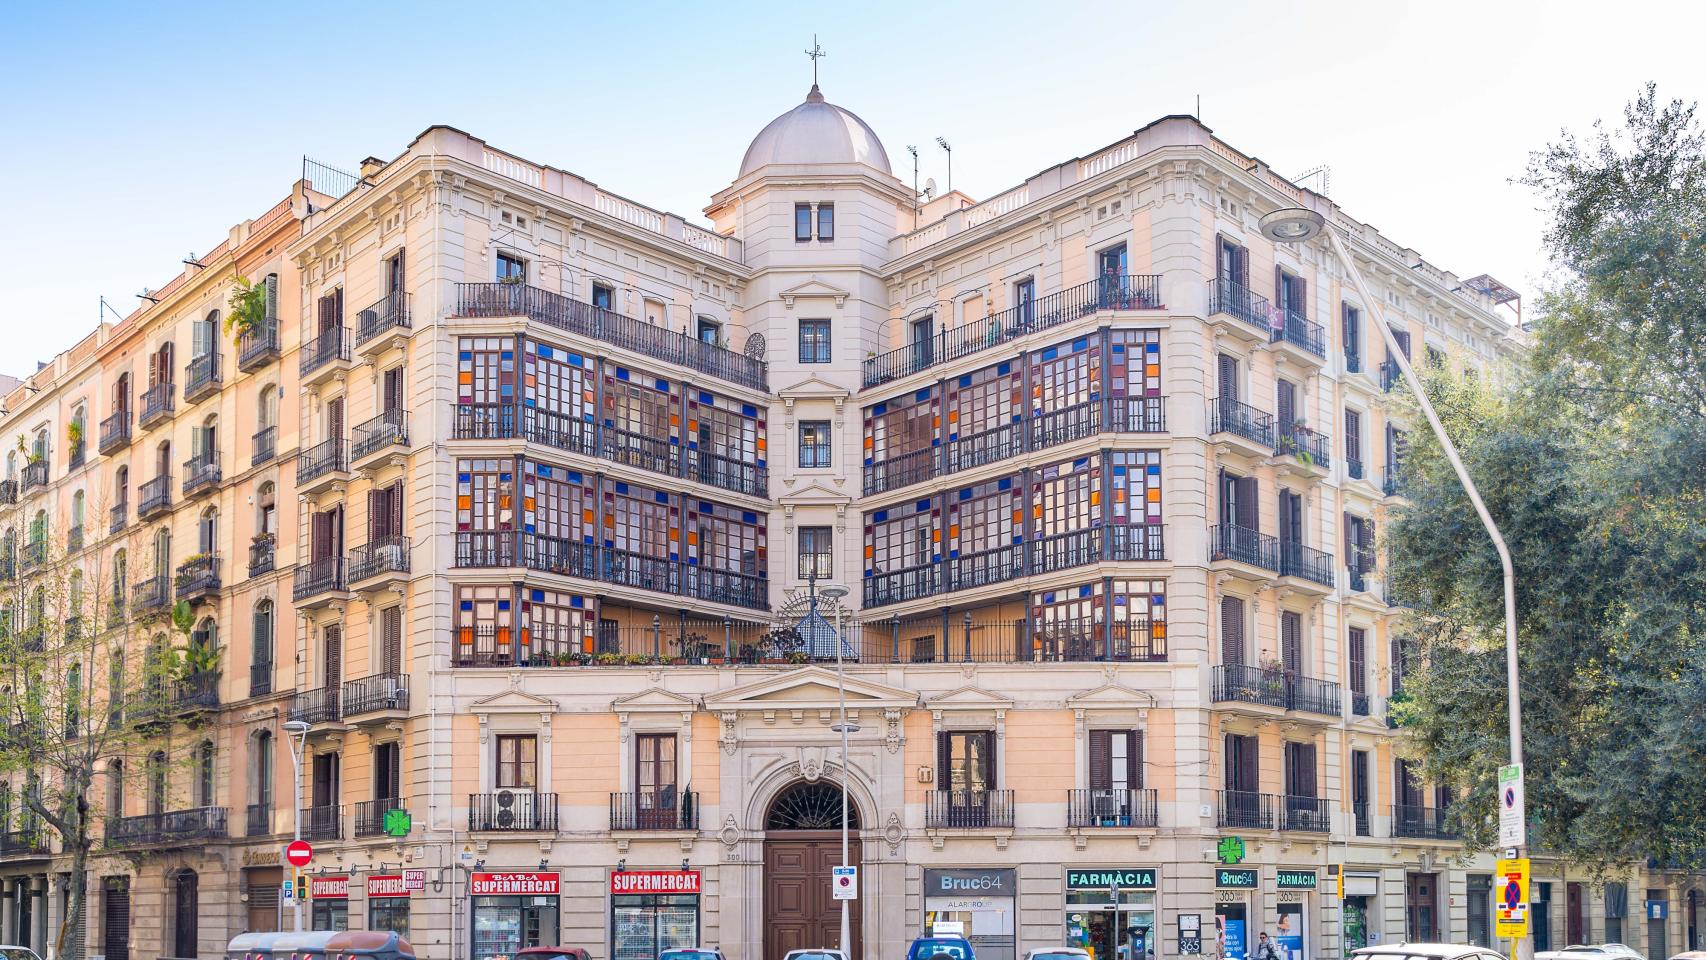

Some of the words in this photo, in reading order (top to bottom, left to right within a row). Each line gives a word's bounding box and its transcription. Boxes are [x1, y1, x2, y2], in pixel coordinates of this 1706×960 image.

[406, 871, 424, 880] SUPER
[613, 874, 698, 890] SUPERMERCAT
[1070, 871, 1153, 885] FARMÀCIA
[1222, 872, 1253, 885] Bruc64
[1277, 872, 1316, 886] FARMÀCIA
[368, 878, 408, 895] SUPERMERC
[474, 880, 557, 892] SUPERMERCAT
[941, 875, 1003, 890] Bruc64
[1136, 939, 1142, 947] P
[1180, 940, 1200, 951] 365
